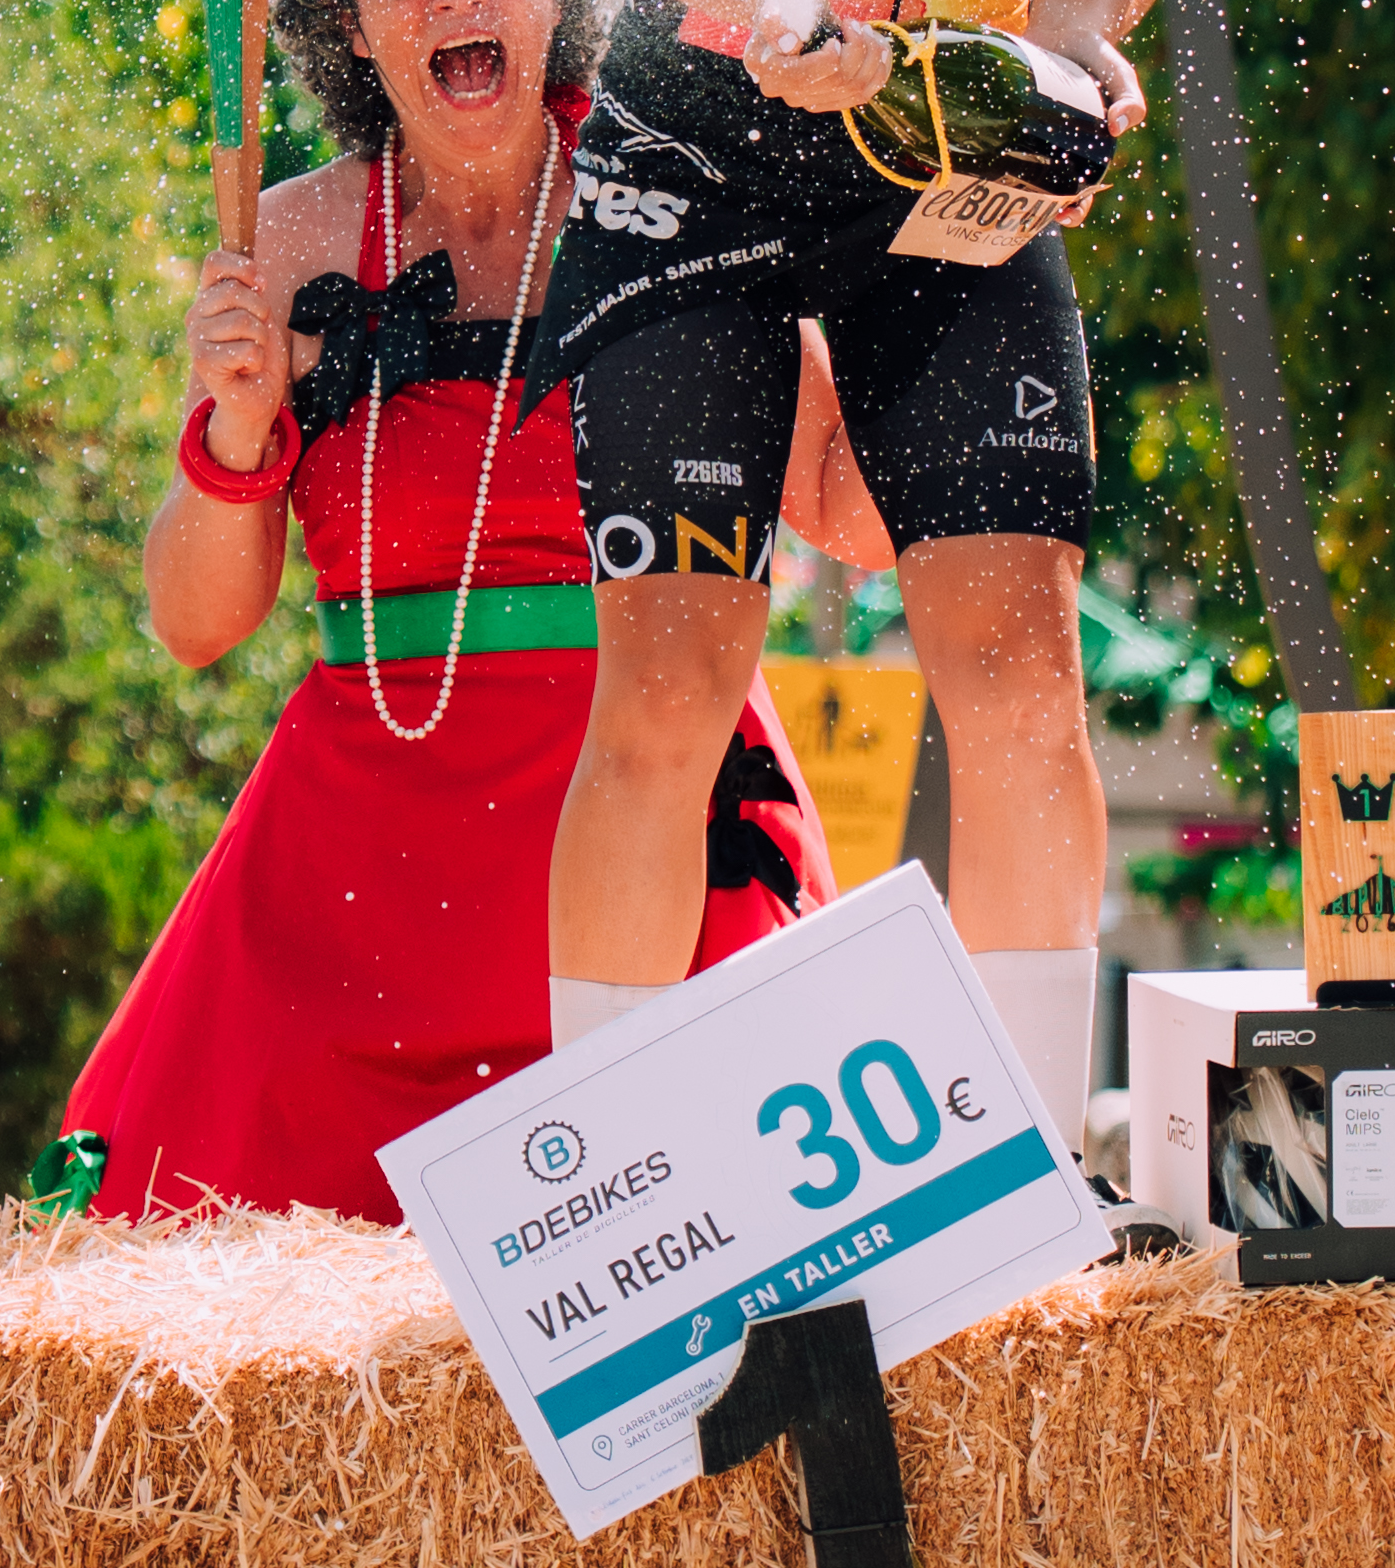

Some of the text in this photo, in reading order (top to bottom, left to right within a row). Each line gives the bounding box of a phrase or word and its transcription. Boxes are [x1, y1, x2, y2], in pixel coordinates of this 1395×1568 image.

[946, 224, 982, 245] VINS
[558, 239, 784, 349] FESTA MAJOR SANT CELONI
[977, 427, 1079, 454] Andorra
[673, 459, 743, 487] 226ERS
[1359, 788, 1370, 817] 1
[1252, 1029, 1317, 1047] GIRO
[1167, 1114, 1196, 1151] GIRO
[1345, 1123, 1382, 1135] MIPS
[537, 1135, 570, 1171] B
[490, 1150, 672, 1269] BDEBIKES
[531, 1194, 656, 1267] TALLER DE BICICLETES
[525, 1210, 736, 1341] VAL REGAL
[737, 1222, 894, 1320] EN TALLER
[618, 1377, 720, 1436] CARRER BARCELONA,
[624, 1407, 690, 1449] SANT CELONI
